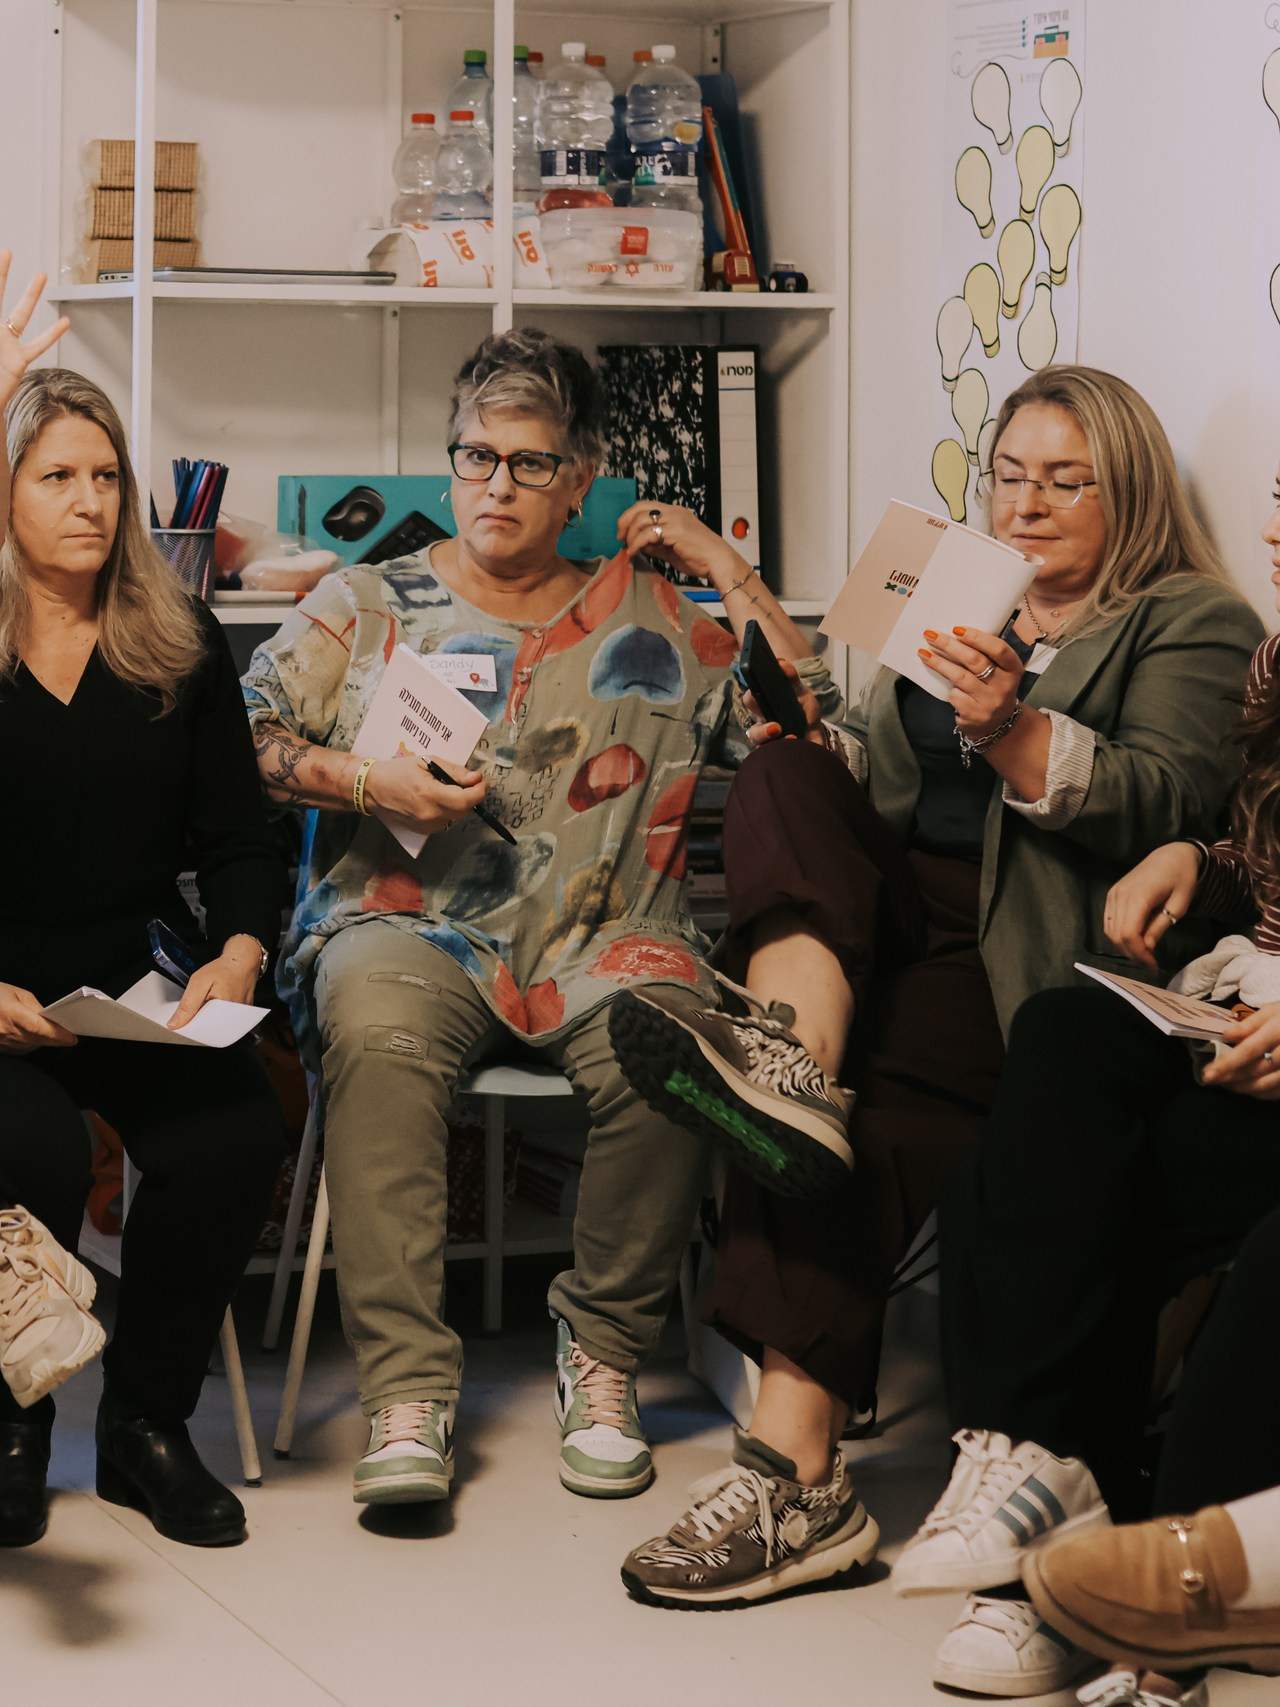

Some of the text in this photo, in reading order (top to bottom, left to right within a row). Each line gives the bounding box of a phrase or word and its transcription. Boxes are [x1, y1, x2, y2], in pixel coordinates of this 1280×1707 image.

[452, 229, 475, 261] סנו
[517, 230, 539, 263] סנו
[588, 263, 674, 273] עזרה ראשונה
[429, 658, 474, 672] Sandy
[440, 725, 453, 743] אני
